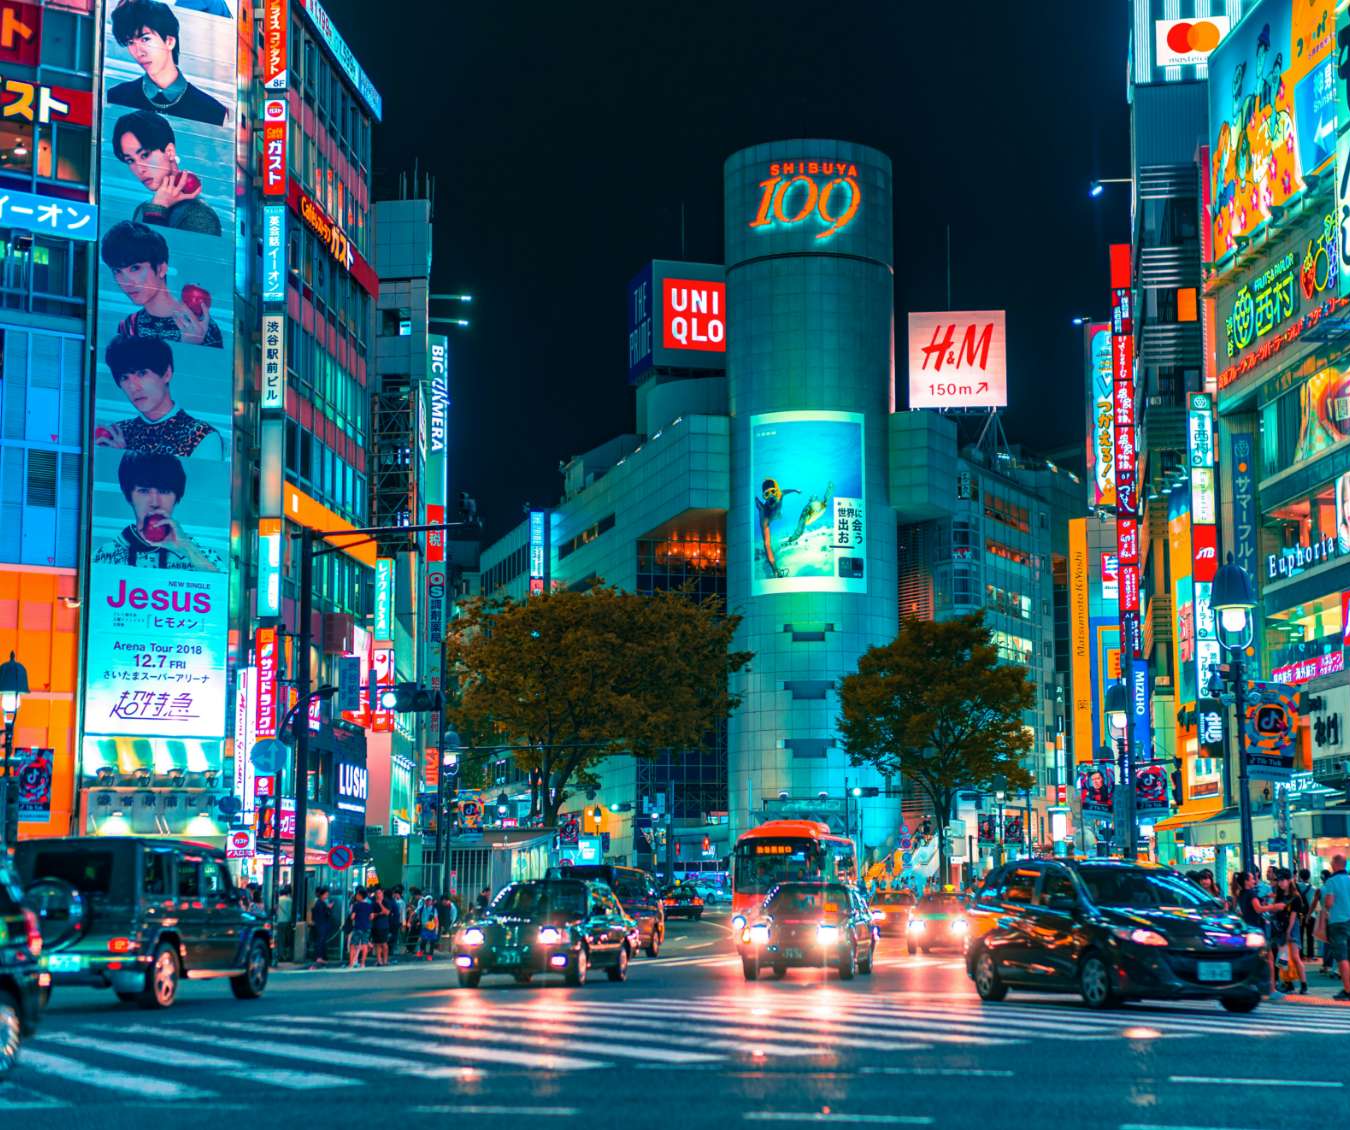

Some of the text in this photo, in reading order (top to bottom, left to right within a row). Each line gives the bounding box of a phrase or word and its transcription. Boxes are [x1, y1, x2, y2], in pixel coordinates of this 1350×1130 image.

[273, 79, 285, 88] 8F
[0, 79, 68, 123] スト
[268, 140, 282, 186] ガスト
[769, 161, 858, 178] SHIBUYA
[748, 175, 861, 239] 109
[634, 281, 647, 325] THE
[671, 287, 719, 315] UNI
[671, 316, 724, 345] QLO
[920, 322, 994, 373] H&M
[266, 320, 280, 401] 渋谷駅前ビル
[432, 345, 444, 374] BIC
[929, 383, 972, 396] 150m
[1235, 474, 1254, 573] サマーフルー
[1267, 535, 1335, 578] Euphoria
[106, 580, 212, 614] Jesus
[186, 581, 211, 590] SINGLE
[113, 640, 203, 655] Arena Tour 2018
[134, 654, 187, 670] 12.7 FRI
[103, 670, 210, 685] さいたまスーパーアリーナ
[1135, 671, 1145, 715] MIZUHO
[339, 762, 367, 800] LUSH
